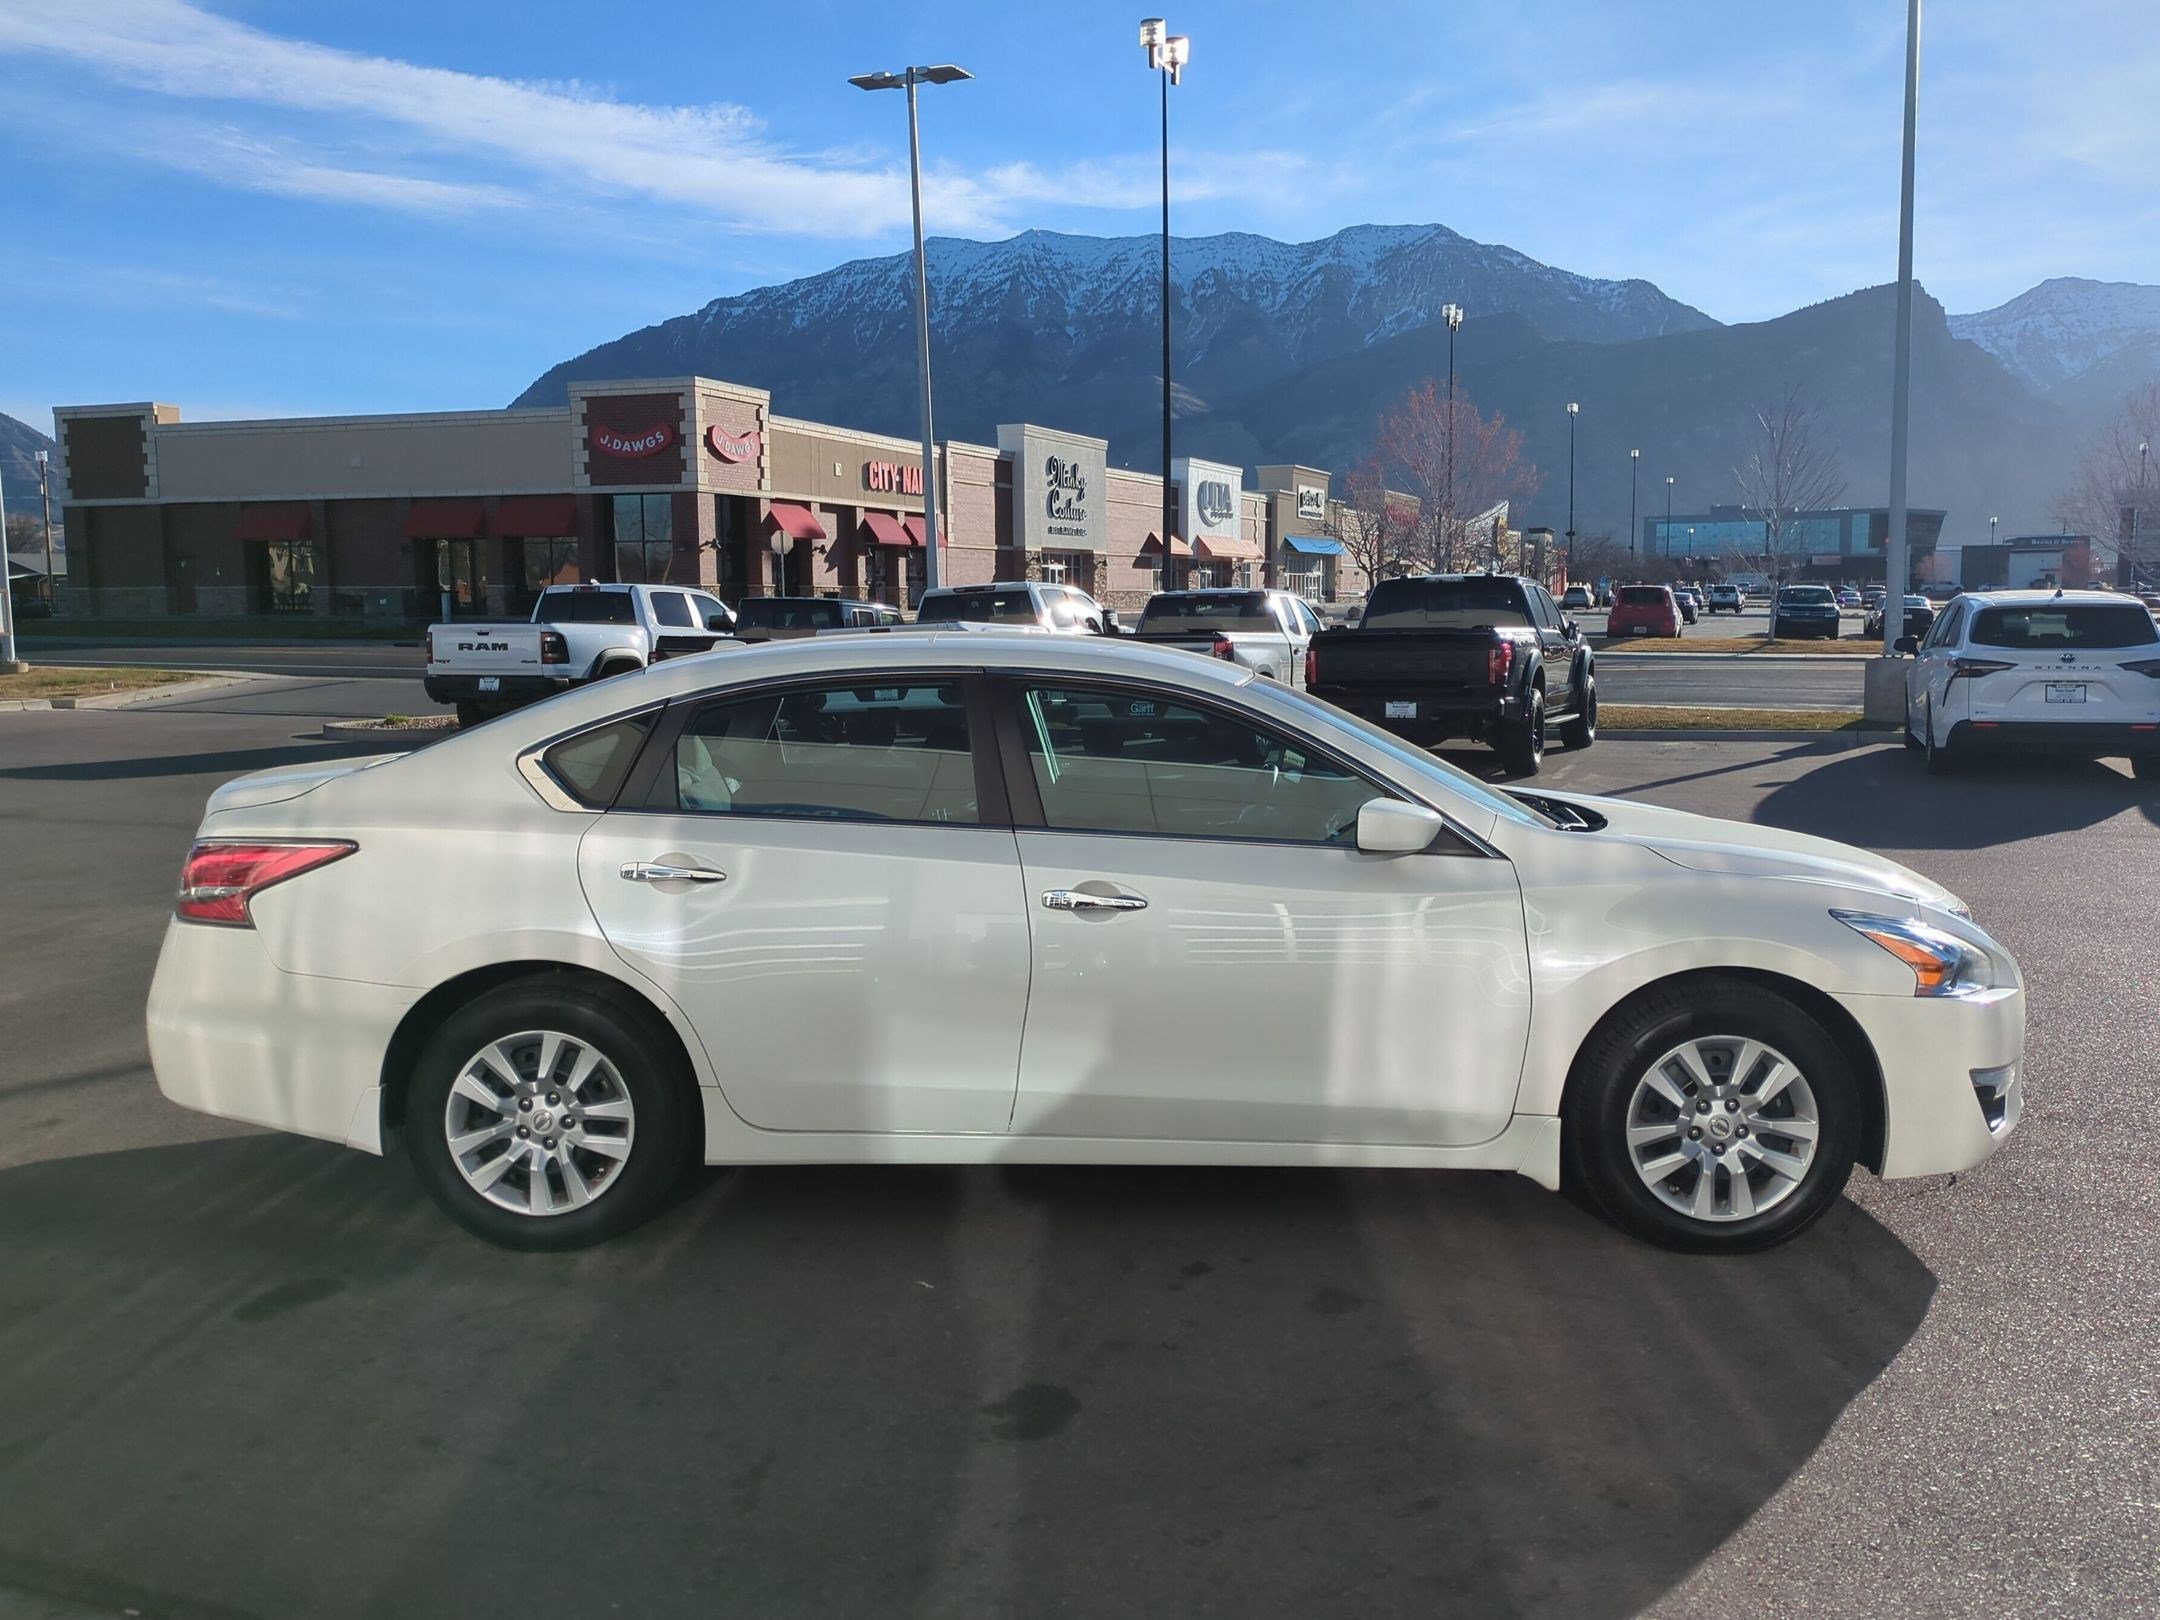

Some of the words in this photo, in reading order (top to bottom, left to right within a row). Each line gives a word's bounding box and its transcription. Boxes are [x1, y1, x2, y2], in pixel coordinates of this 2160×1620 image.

[600, 431, 664, 452] J.DAWGS
[869, 461, 897, 492] CITY
[458, 642, 509, 651] RAM
